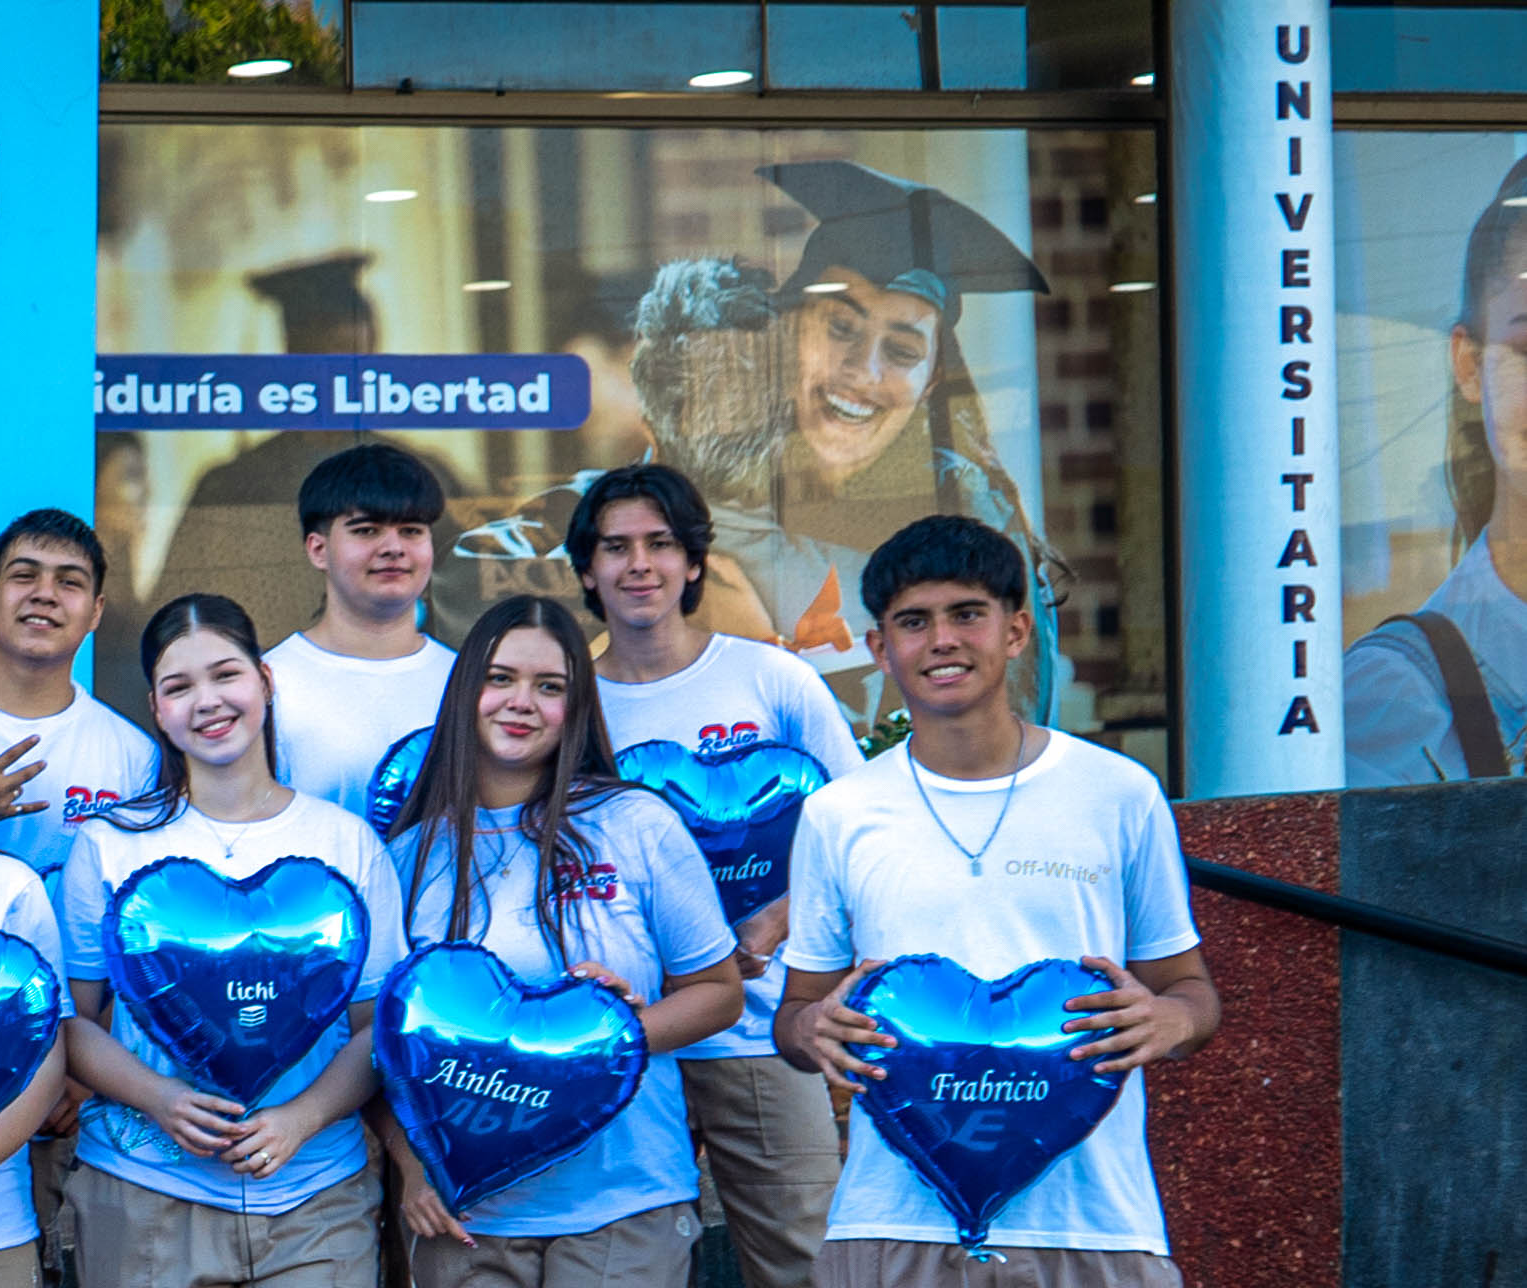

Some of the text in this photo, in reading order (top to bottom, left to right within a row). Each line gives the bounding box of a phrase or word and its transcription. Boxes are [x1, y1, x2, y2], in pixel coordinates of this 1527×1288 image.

[259, 382, 317, 414] es
[333, 371, 550, 414] Libertad
[1275, 25, 1321, 736] UNIVERSITARIA
[227, 980, 279, 1001] Lichi
[423, 1058, 552, 1109] Ainhara
[931, 1069, 1050, 1102] Frabricio
